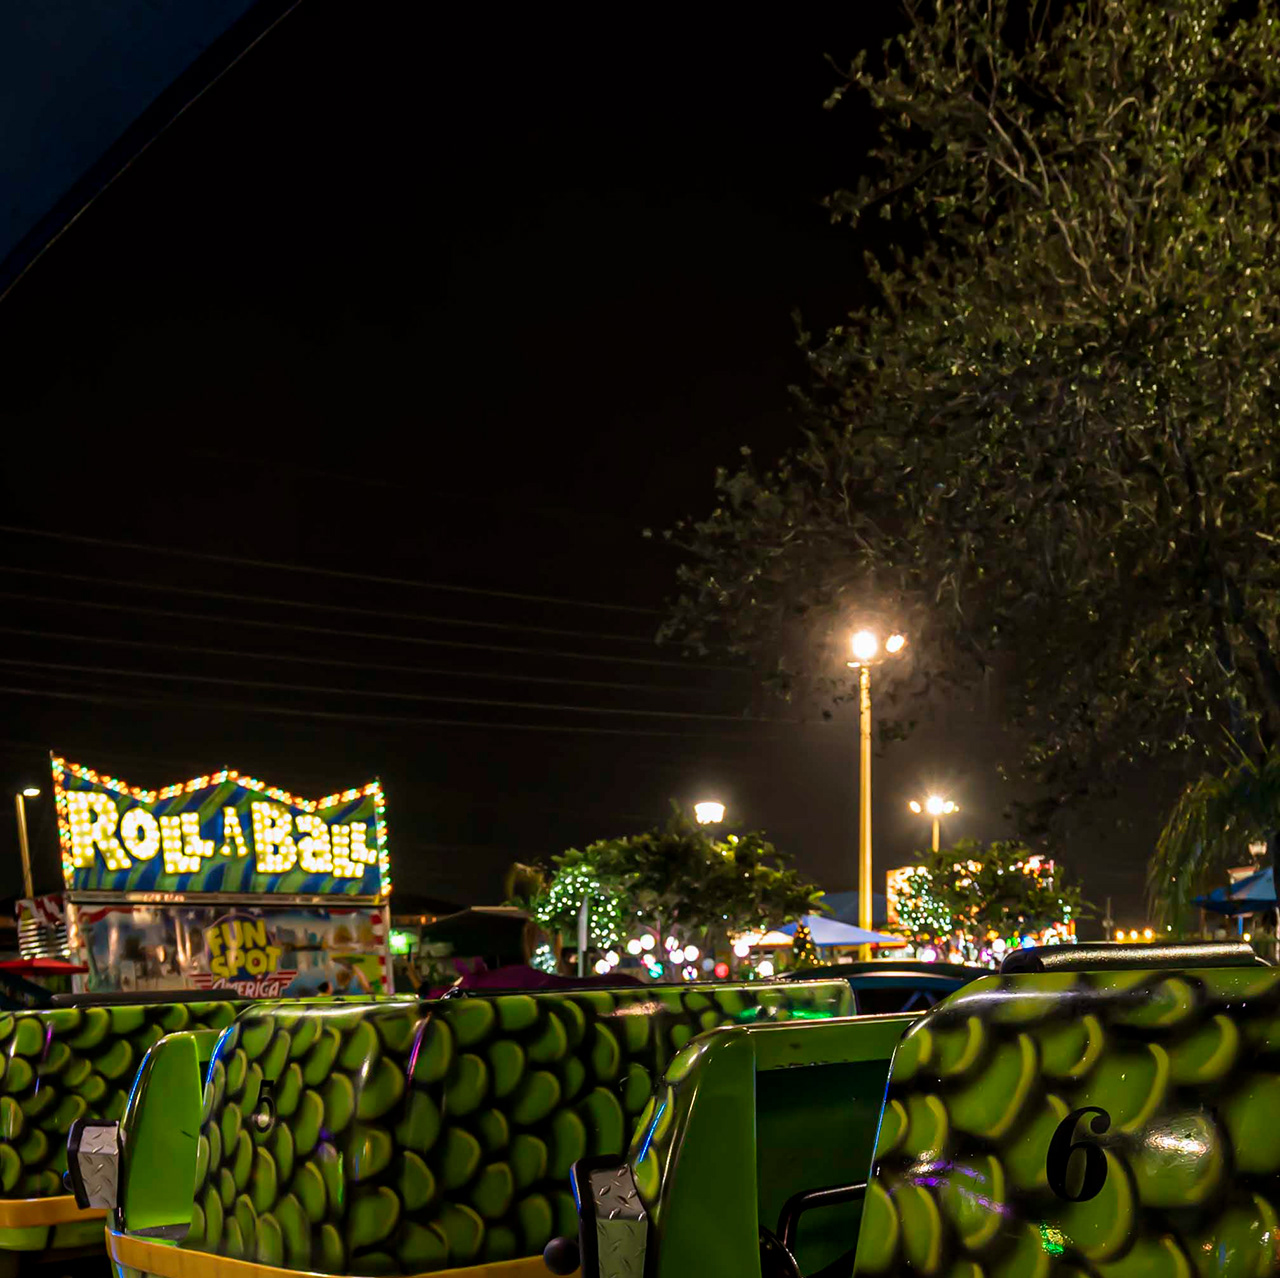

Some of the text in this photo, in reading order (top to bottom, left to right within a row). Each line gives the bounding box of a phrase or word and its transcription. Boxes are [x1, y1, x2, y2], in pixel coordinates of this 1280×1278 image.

[220, 806, 249, 858] A
[205, 919, 267, 957] FUN
[210, 945, 281, 982] SPOT
[256, 1080, 275, 1133] 5
[1046, 1106, 1111, 1202] 6
